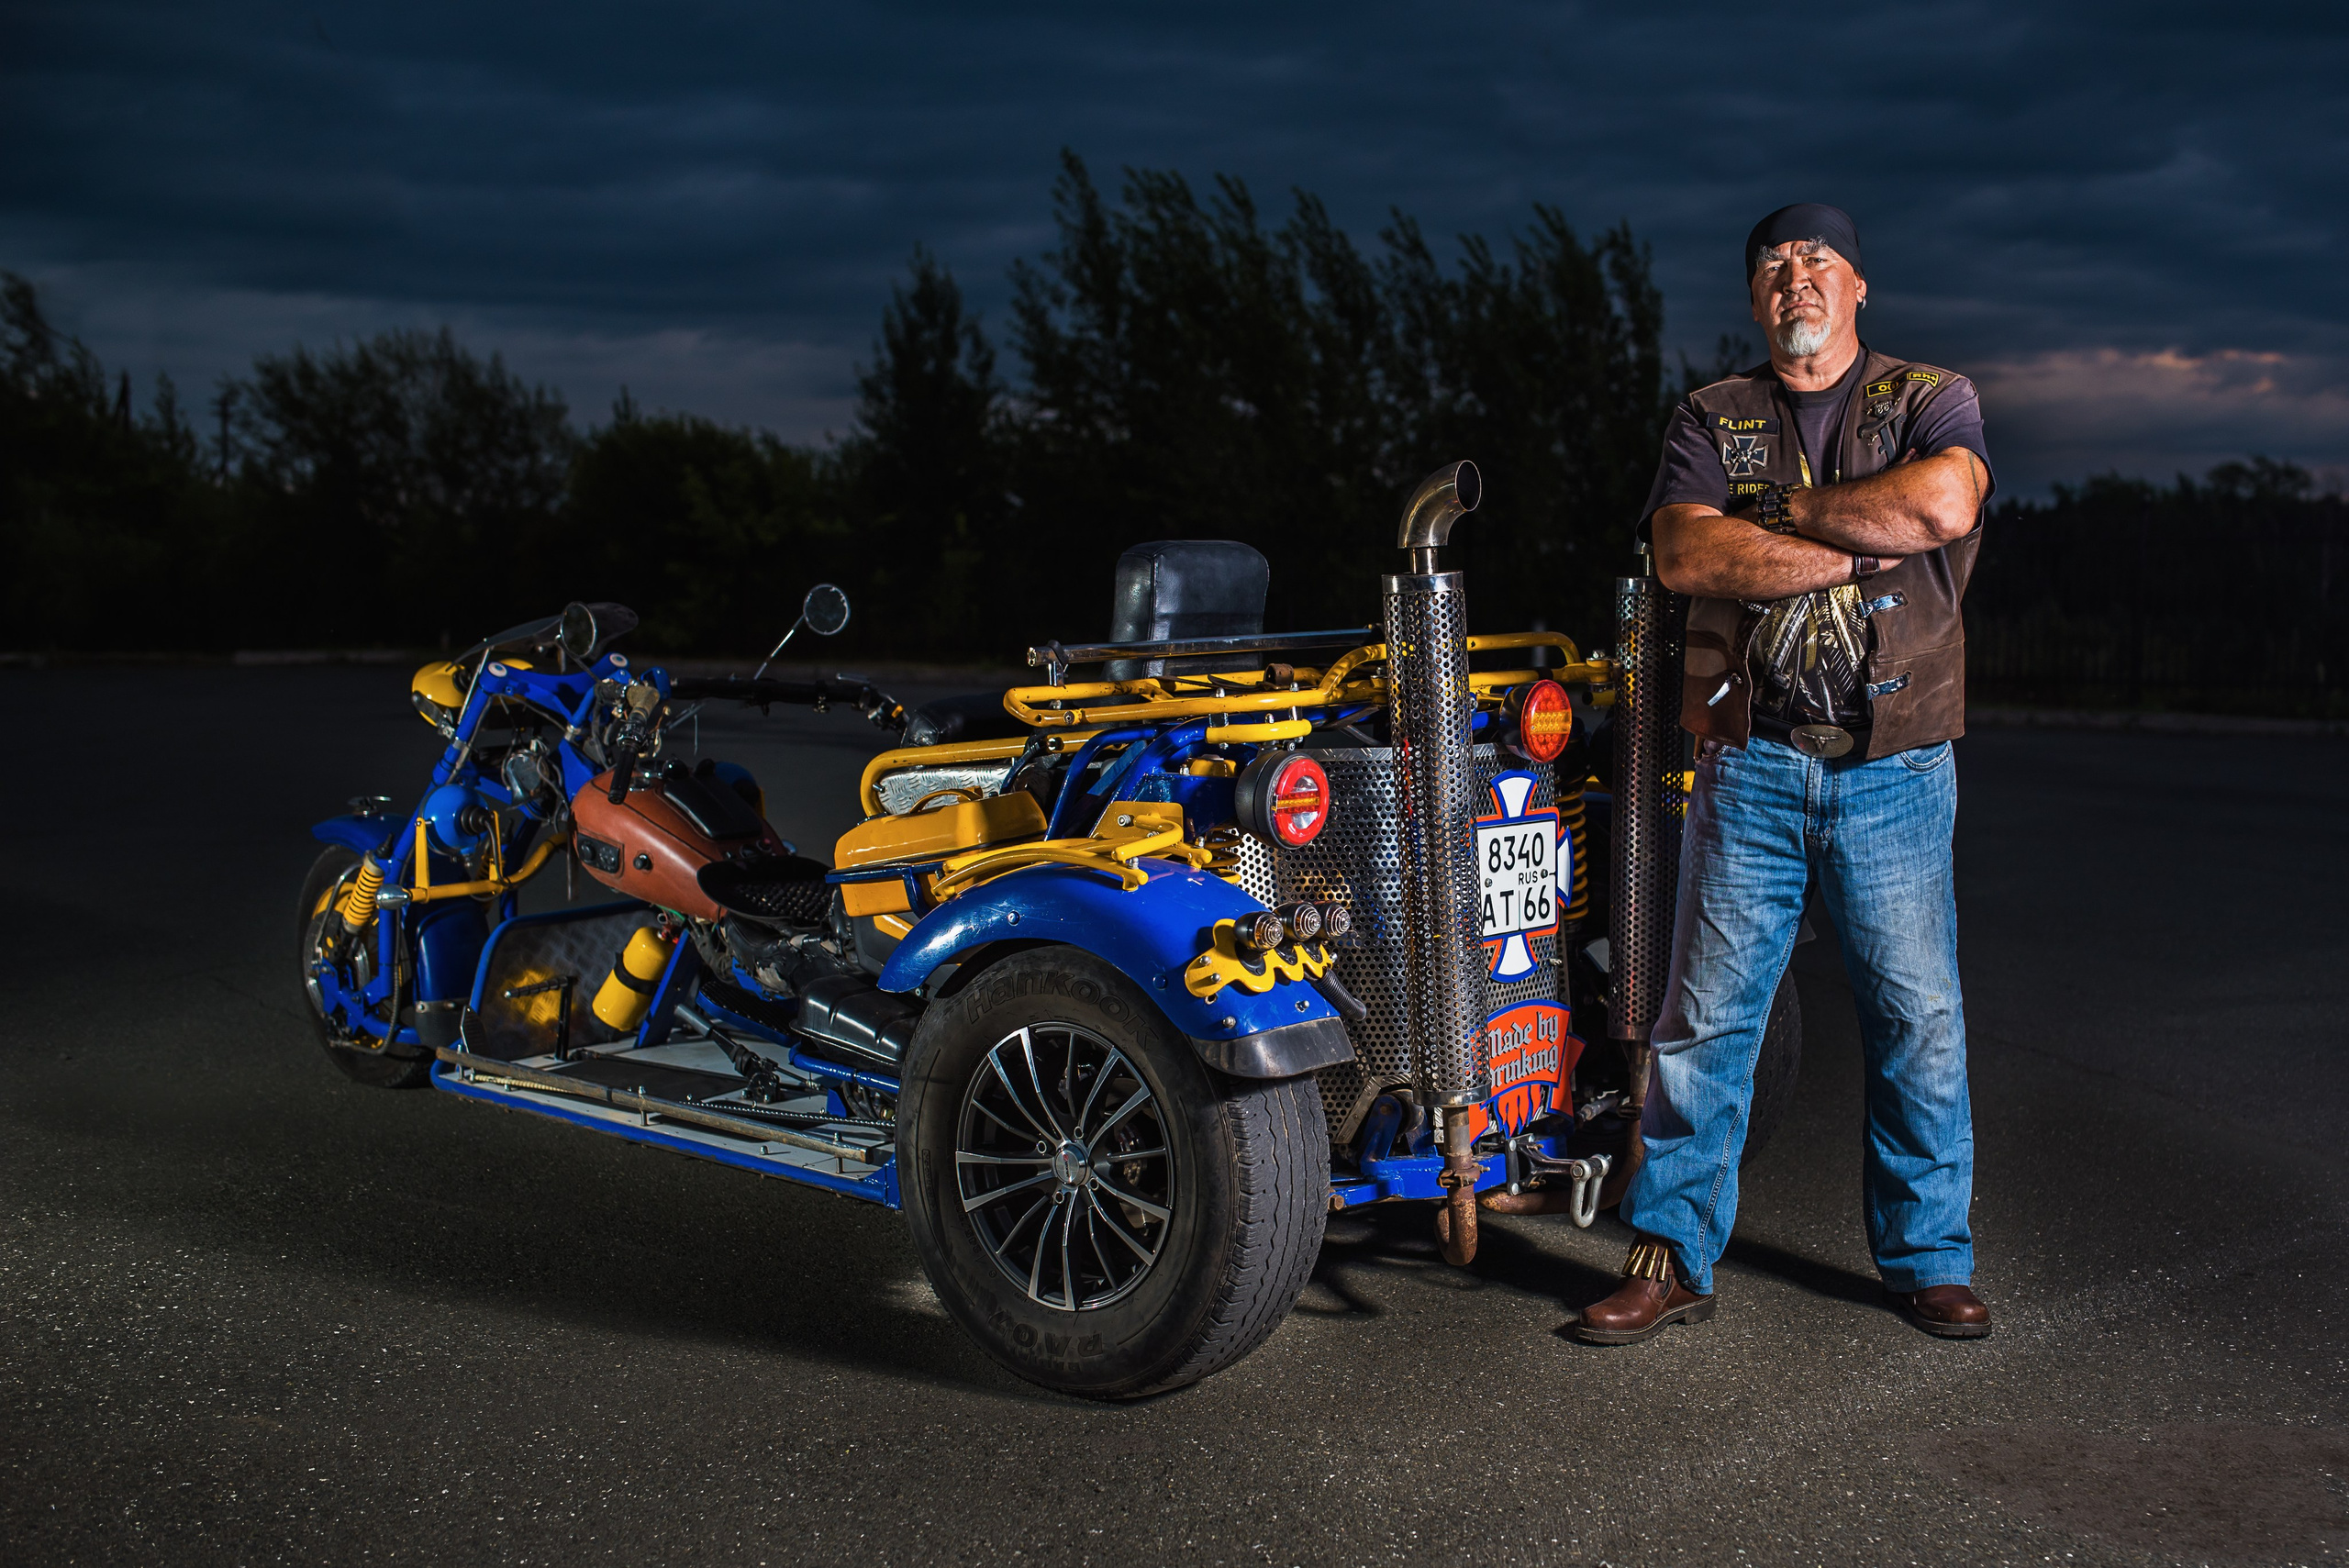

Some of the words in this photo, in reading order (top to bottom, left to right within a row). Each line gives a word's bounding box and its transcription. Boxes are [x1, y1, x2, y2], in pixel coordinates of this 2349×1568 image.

[1719, 417, 1766, 430] FLINT
[1488, 832, 1543, 873] 8340
[1519, 871, 1538, 885] RUS
[1482, 890, 1514, 928] AT
[1524, 884, 1550, 921] 66
[1488, 1022, 1532, 1059] Made
[1536, 1011, 1559, 1043] by
